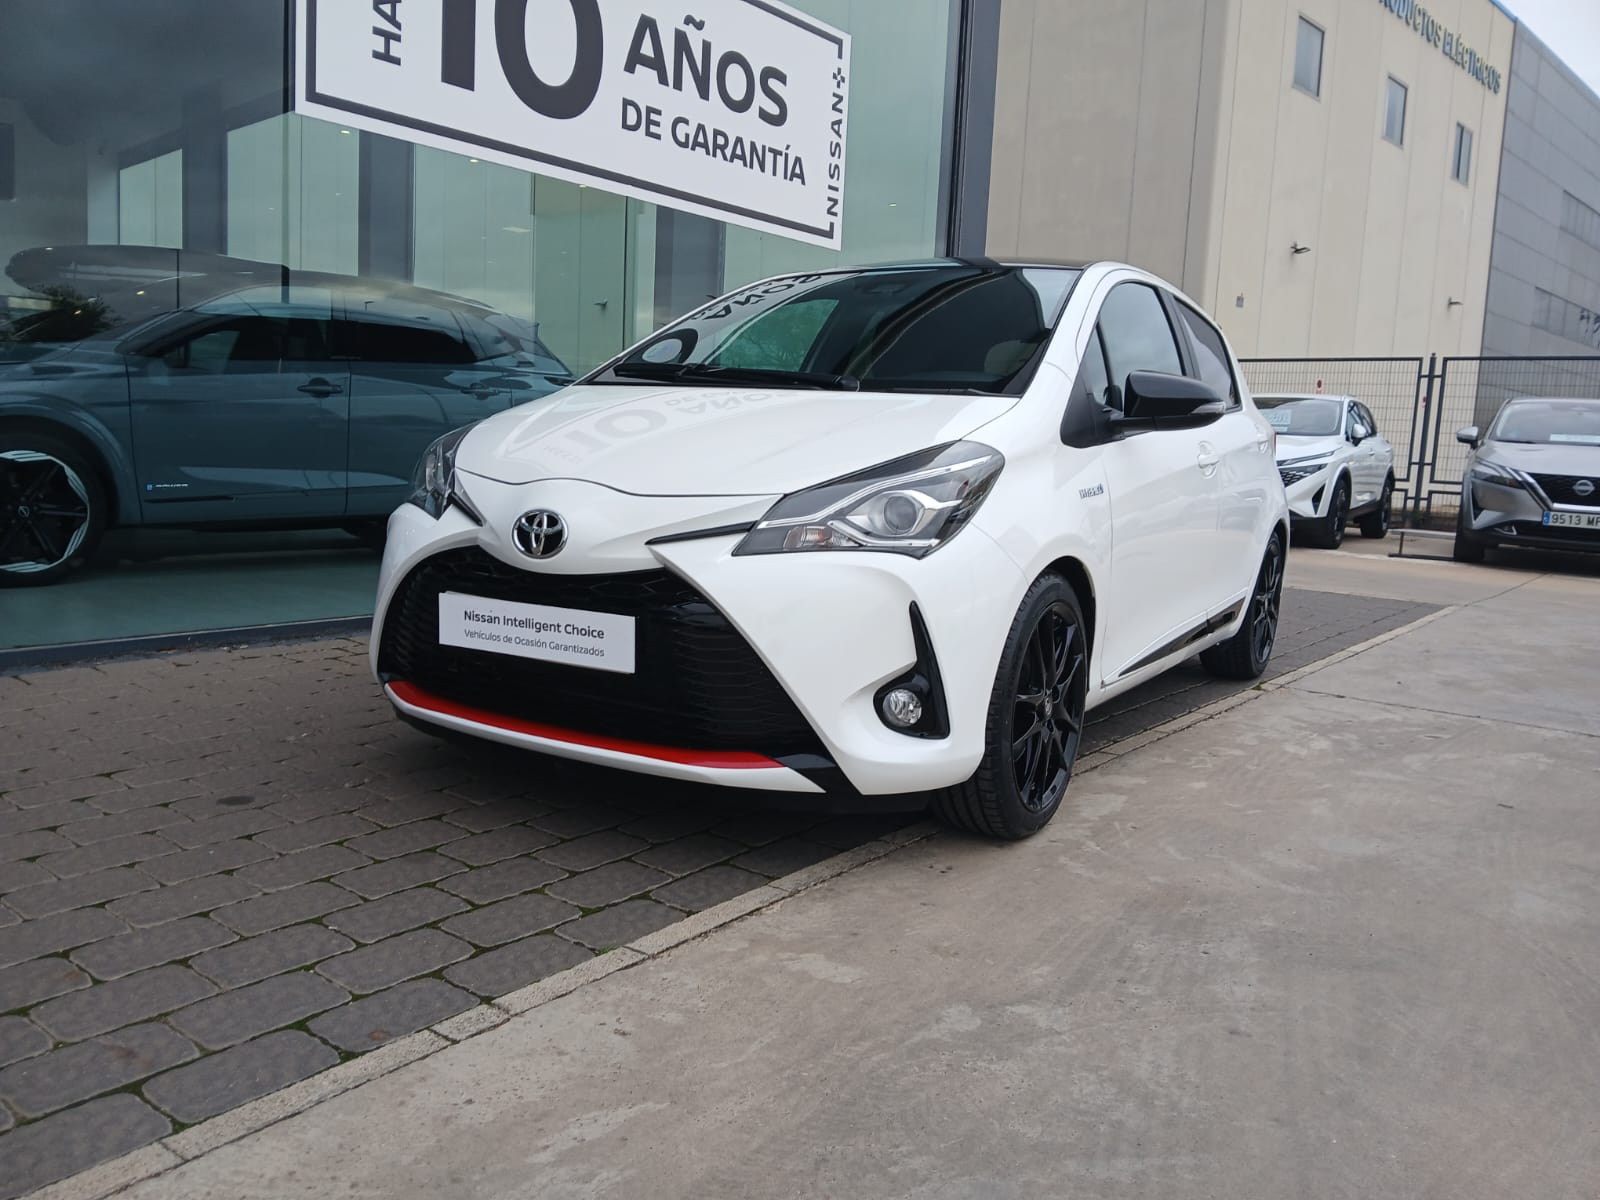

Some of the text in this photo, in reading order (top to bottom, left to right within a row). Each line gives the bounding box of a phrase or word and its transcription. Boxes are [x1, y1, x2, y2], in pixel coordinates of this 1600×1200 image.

[441, 0, 788, 127] 10 AÑOS
[621, 97, 806, 186] DE GARANTÍA
[1552, 514, 1582, 526] 9513
[464, 610, 605, 639] Nissan Intelligent Choice
[464, 628, 605, 658] Vehículos de Ocasión Garantizados
